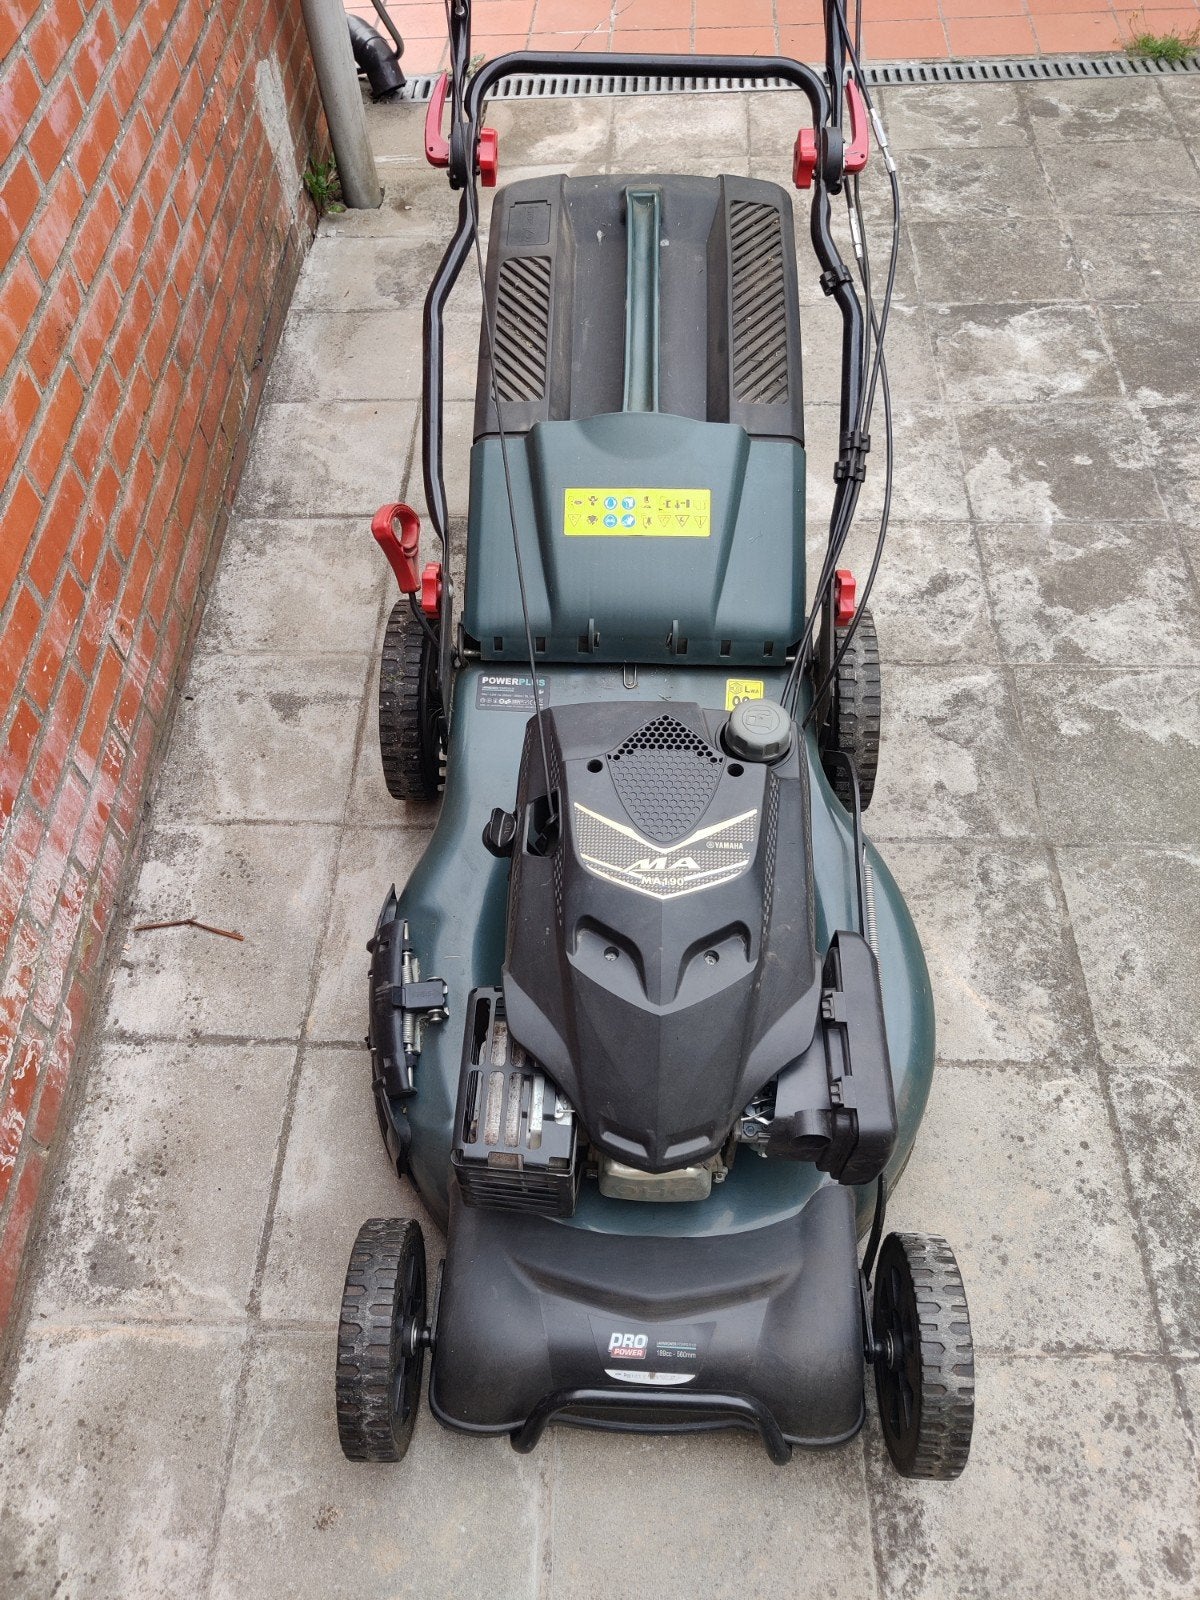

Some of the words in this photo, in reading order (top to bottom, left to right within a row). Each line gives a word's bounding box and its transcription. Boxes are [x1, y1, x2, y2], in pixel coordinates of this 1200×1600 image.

[714, 841, 744, 849] YAMAHA
[624, 856, 701, 870] MA
[641, 876, 685, 887] MA190
[608, 1332, 649, 1352] PRO
[614, 1348, 643, 1357] POWER
